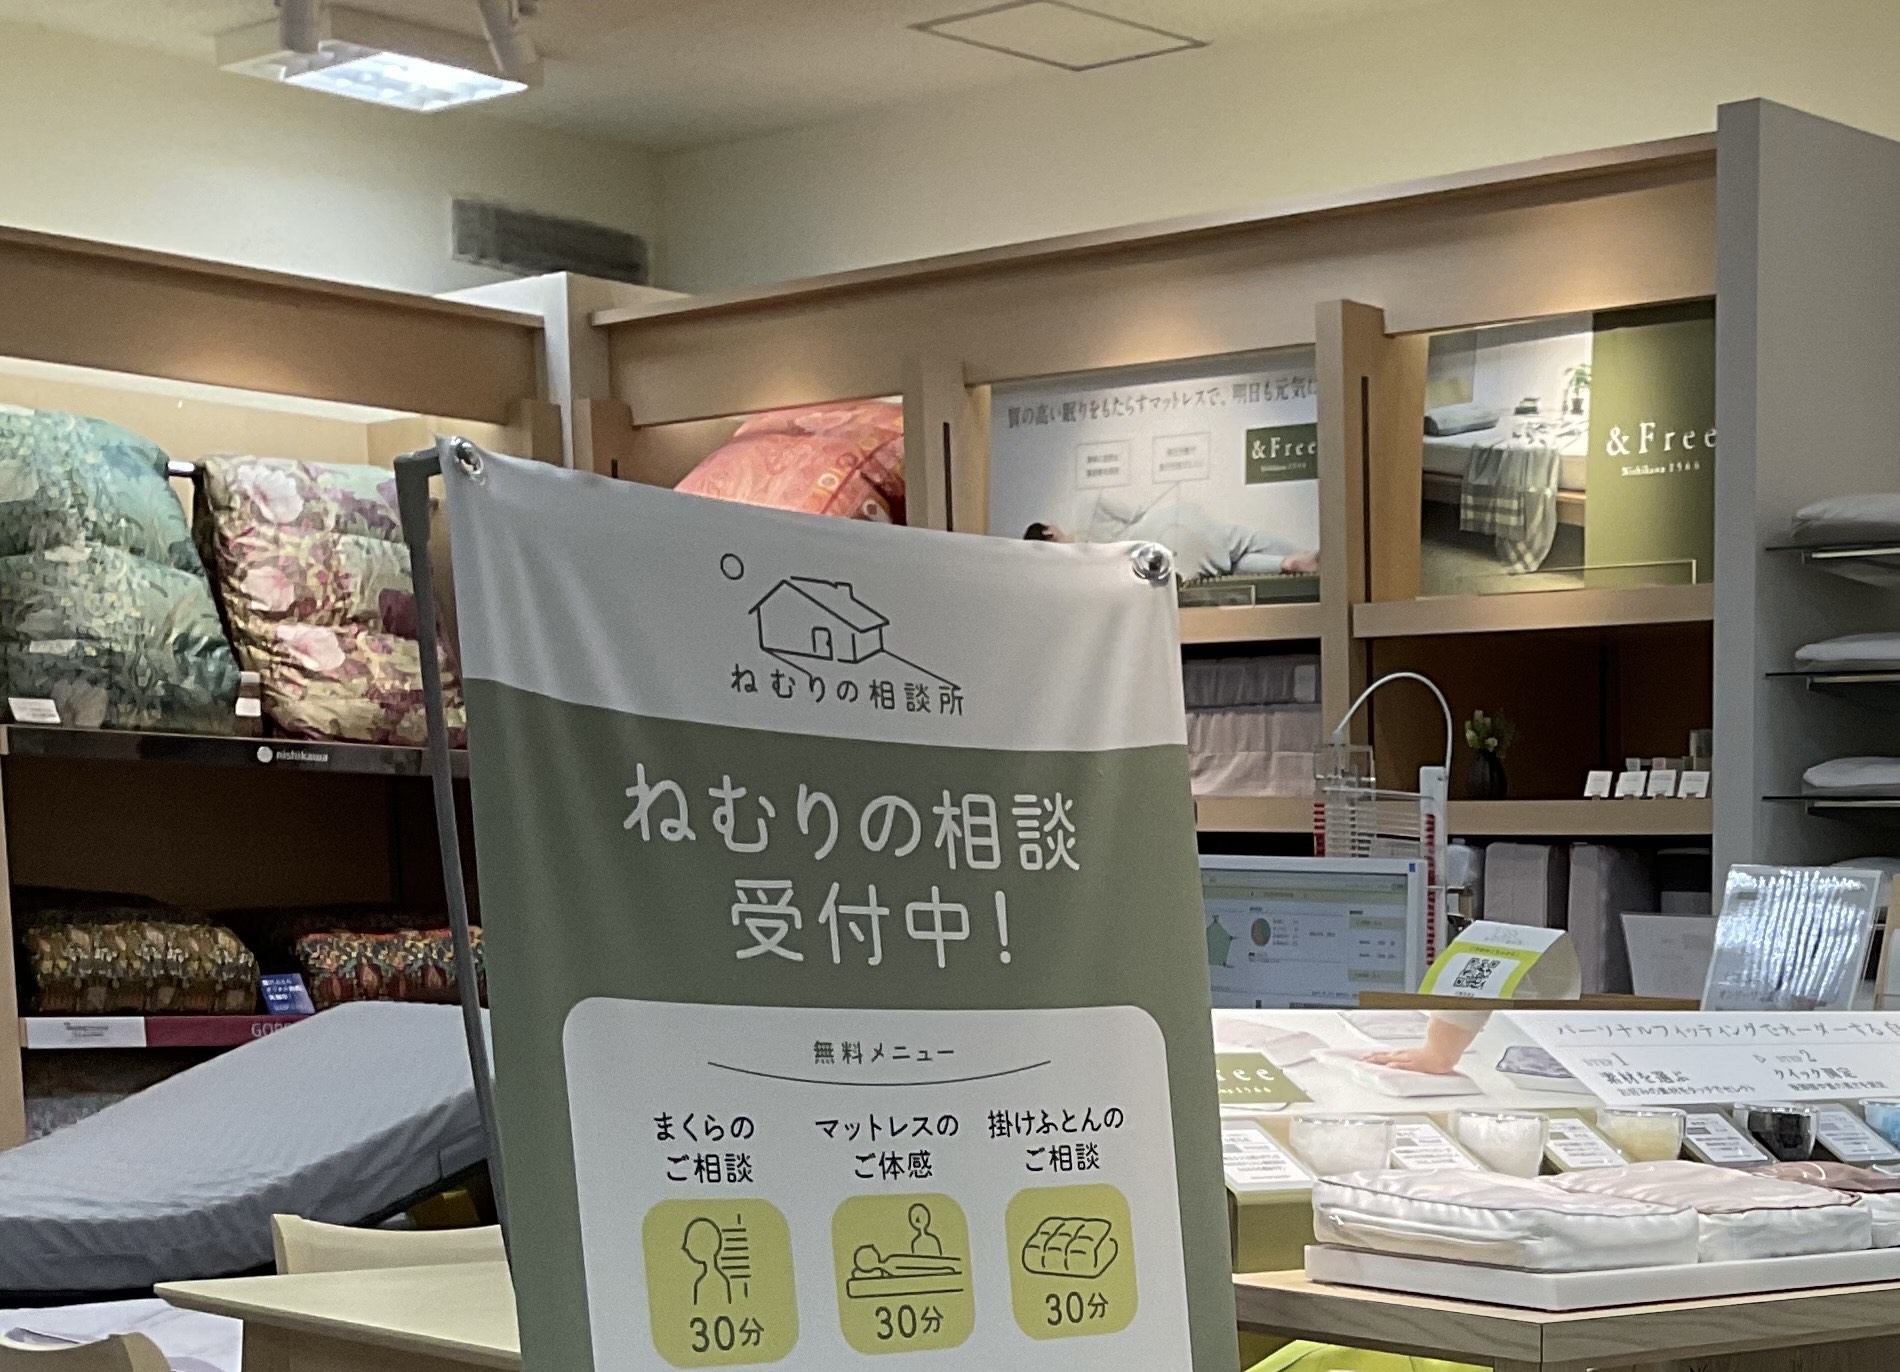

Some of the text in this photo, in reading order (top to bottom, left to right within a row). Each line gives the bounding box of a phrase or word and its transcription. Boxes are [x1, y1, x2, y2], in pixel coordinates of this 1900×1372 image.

[1605, 421, 1718, 456] &Free
[731, 661, 964, 718] ねむりの相談所
[622, 762, 1082, 872] ねむりの相談
[729, 877, 1014, 970] 受付中!
[812, 1040, 955, 1066] 無料メニュー
[653, 1111, 756, 1142] まくらの
[814, 1112, 960, 1140] マットレスの
[987, 1106, 1126, 1138] 掛けふとんの
[664, 1152, 755, 1186] ご相談
[853, 1148, 934, 1181] ご体感
[1023, 1142, 1101, 1175] ご相談
[875, 1305, 945, 1342] 30分
[1045, 1291, 1110, 1327] 30分
[688, 1315, 766, 1355] 30分
